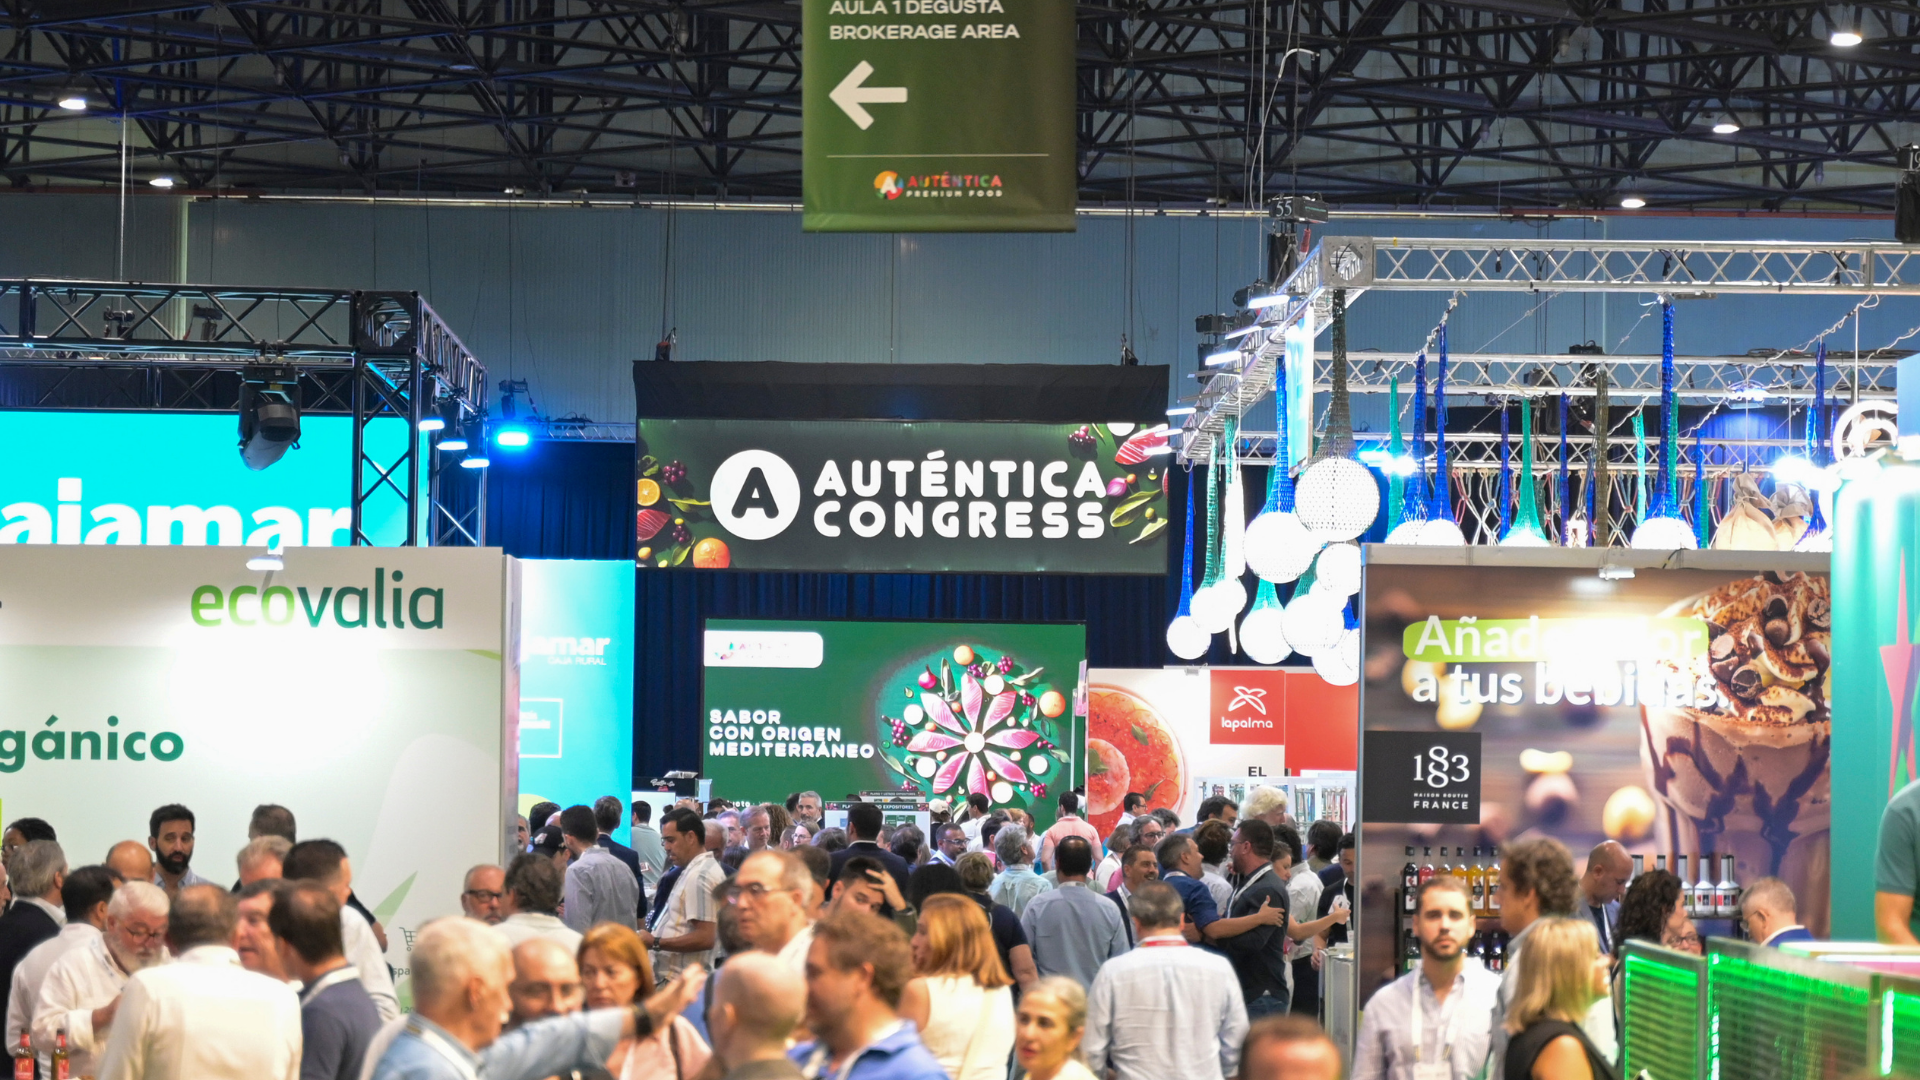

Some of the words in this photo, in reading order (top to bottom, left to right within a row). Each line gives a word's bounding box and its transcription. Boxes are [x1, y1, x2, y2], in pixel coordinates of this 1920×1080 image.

[829, 0, 888, 14] AULA
[905, 0, 1004, 14] DEGUSTA
[829, 25, 957, 40] BROKERAGE
[961, 24, 1020, 39] AREA
[907, 171, 1002, 187] AUTÉNTICA
[1276, 200, 1292, 217] 55
[813, 450, 1107, 498] AUTÉNTICA
[813, 500, 1105, 539] CONGRESS
[190, 567, 444, 630] ecovalia
[1412, 671, 1437, 702] a
[1450, 665, 1523, 704] tus
[709, 709, 781, 724] SABOR
[1221, 717, 1273, 732] lapalma
[709, 725, 754, 740] CON
[761, 726, 841, 741] ORIGEN
[0, 714, 184, 773] gánico
[709, 741, 875, 759] MEDITERRÁNEO
[1248, 766, 1267, 777] EL
[1413, 800, 1469, 809] FRANCE
